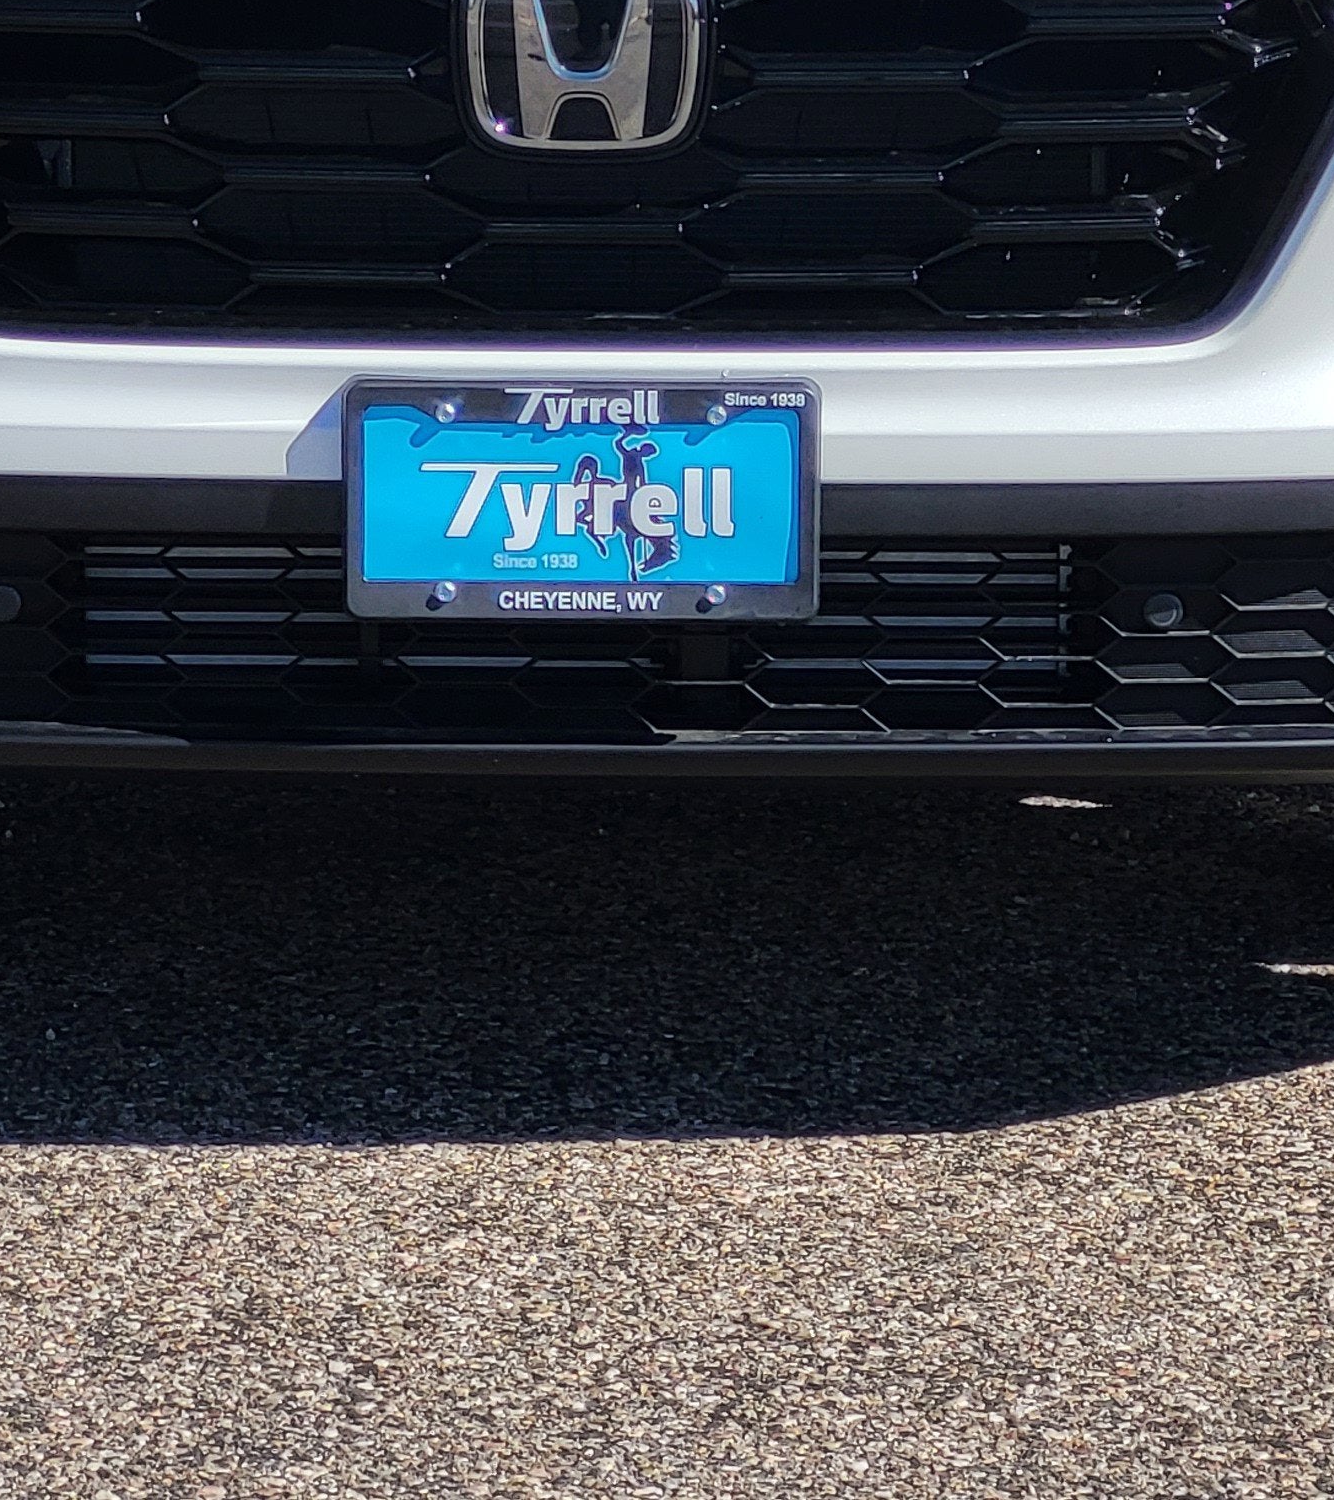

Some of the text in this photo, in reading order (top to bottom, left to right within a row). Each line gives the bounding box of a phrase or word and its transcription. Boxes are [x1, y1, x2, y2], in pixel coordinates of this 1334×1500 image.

[504, 387, 661, 431] Tyrrell
[724, 392, 806, 408] Since 1938
[419, 461, 735, 552] Tyrrell
[492, 553, 578, 569] Since 1938
[498, 591, 663, 613] CHEYENNE, WY
